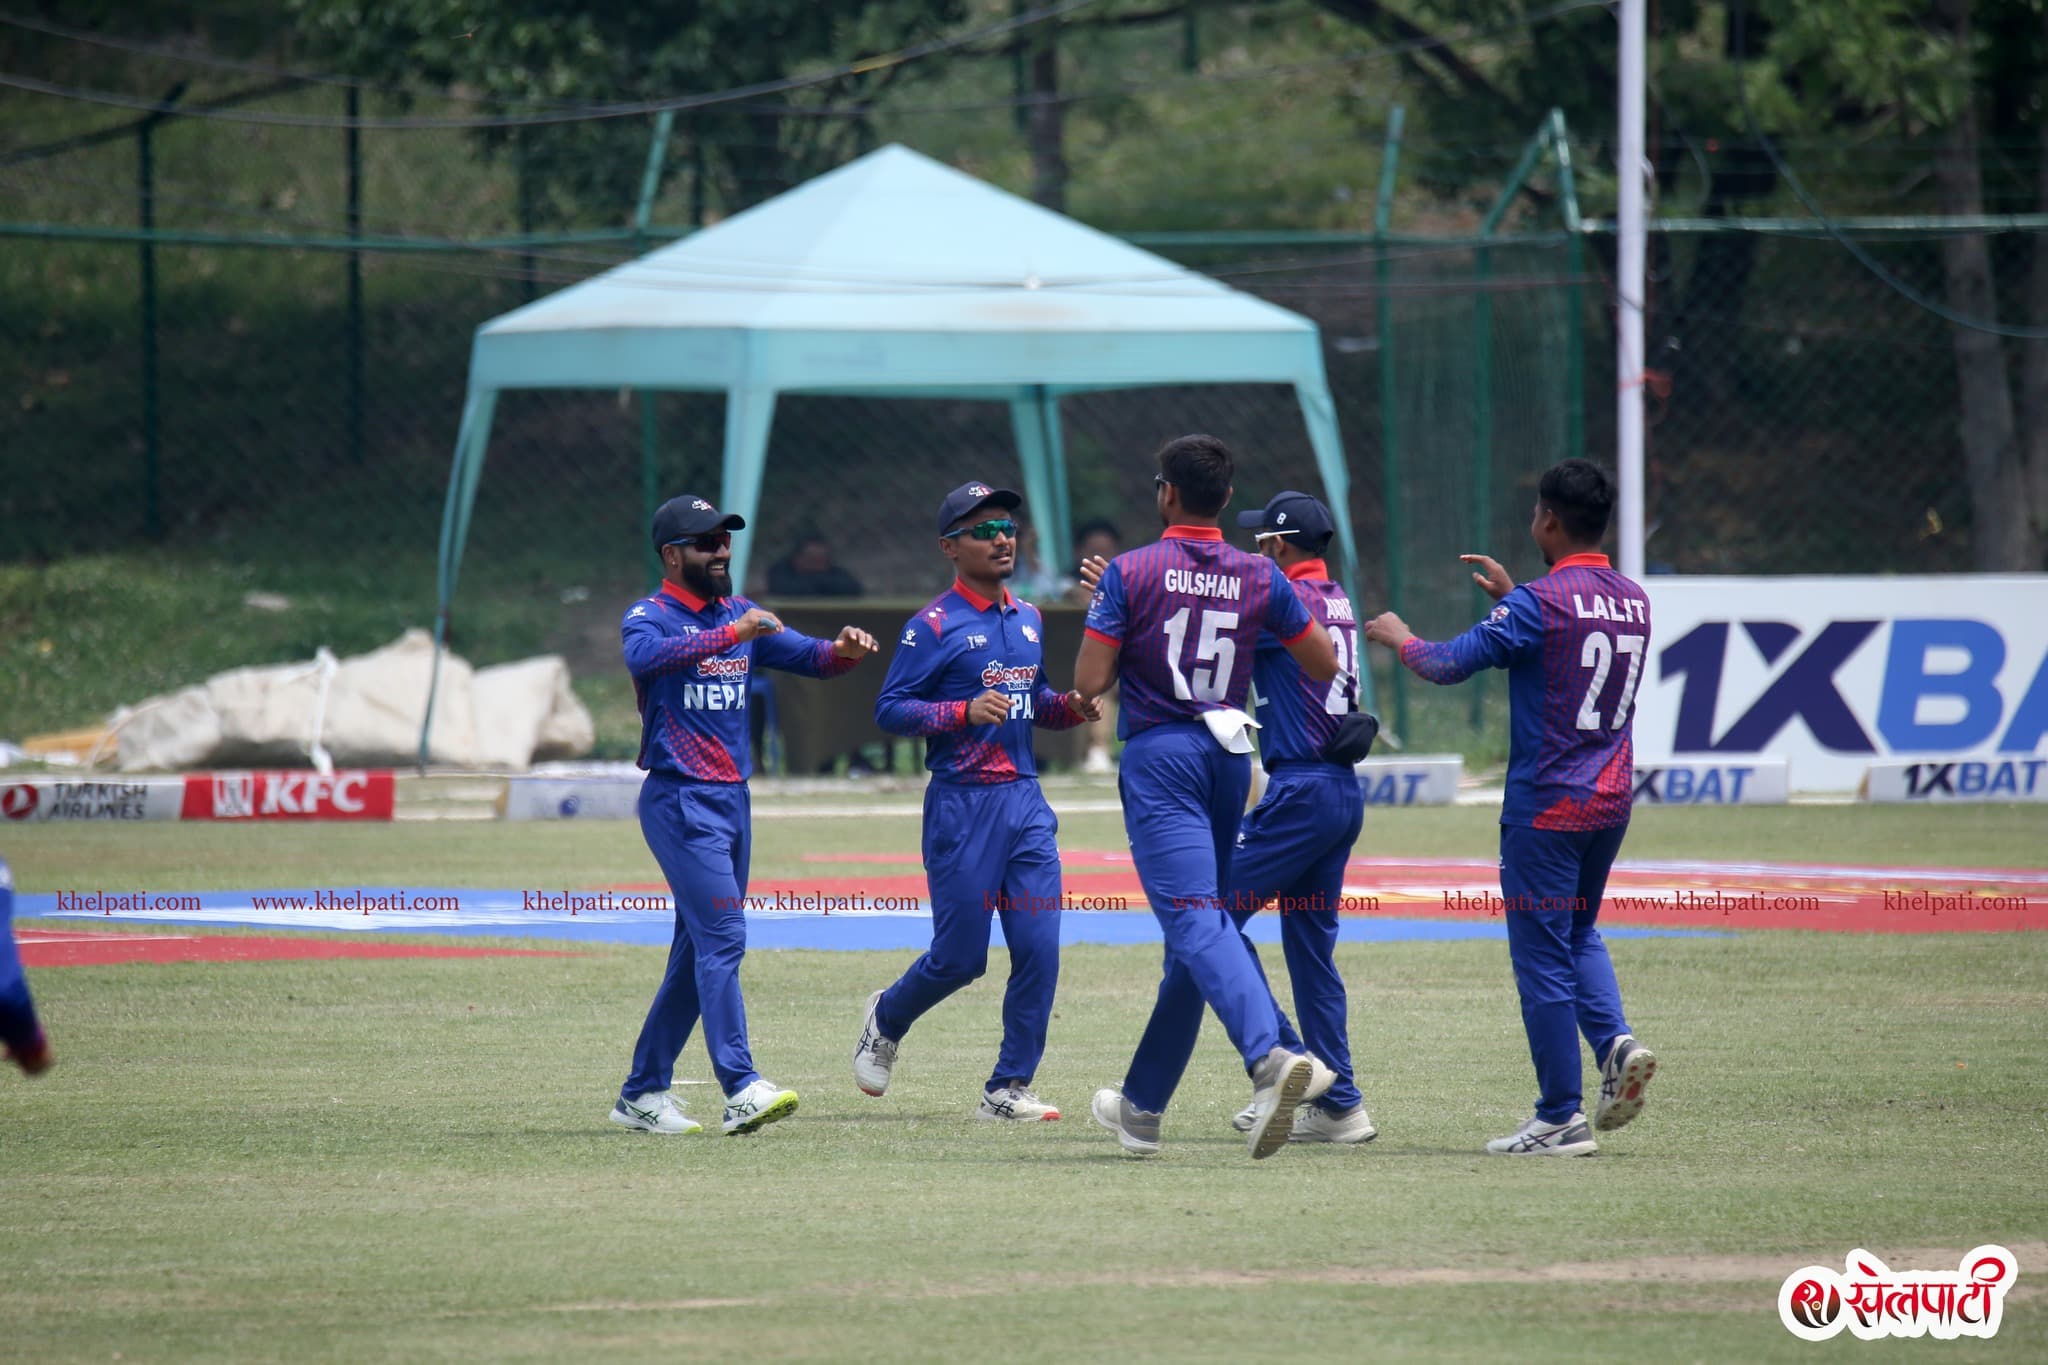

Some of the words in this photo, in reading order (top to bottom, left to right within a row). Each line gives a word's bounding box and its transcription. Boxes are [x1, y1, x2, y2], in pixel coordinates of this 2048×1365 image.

[1164, 568, 1241, 601] GULSHAN
[1573, 594, 1645, 625] LALIT
[697, 655, 749, 677] Second
[1163, 607, 1240, 702] 15
[982, 664, 1039, 688] Second
[1575, 631, 1645, 731] 27
[683, 684, 746, 711] NEPA
[260, 774, 367, 814] KFC
[1633, 767, 1755, 804] XBAT
[1903, 761, 2047, 799] 1XBAT
[49, 802, 145, 819] AIRLINES
